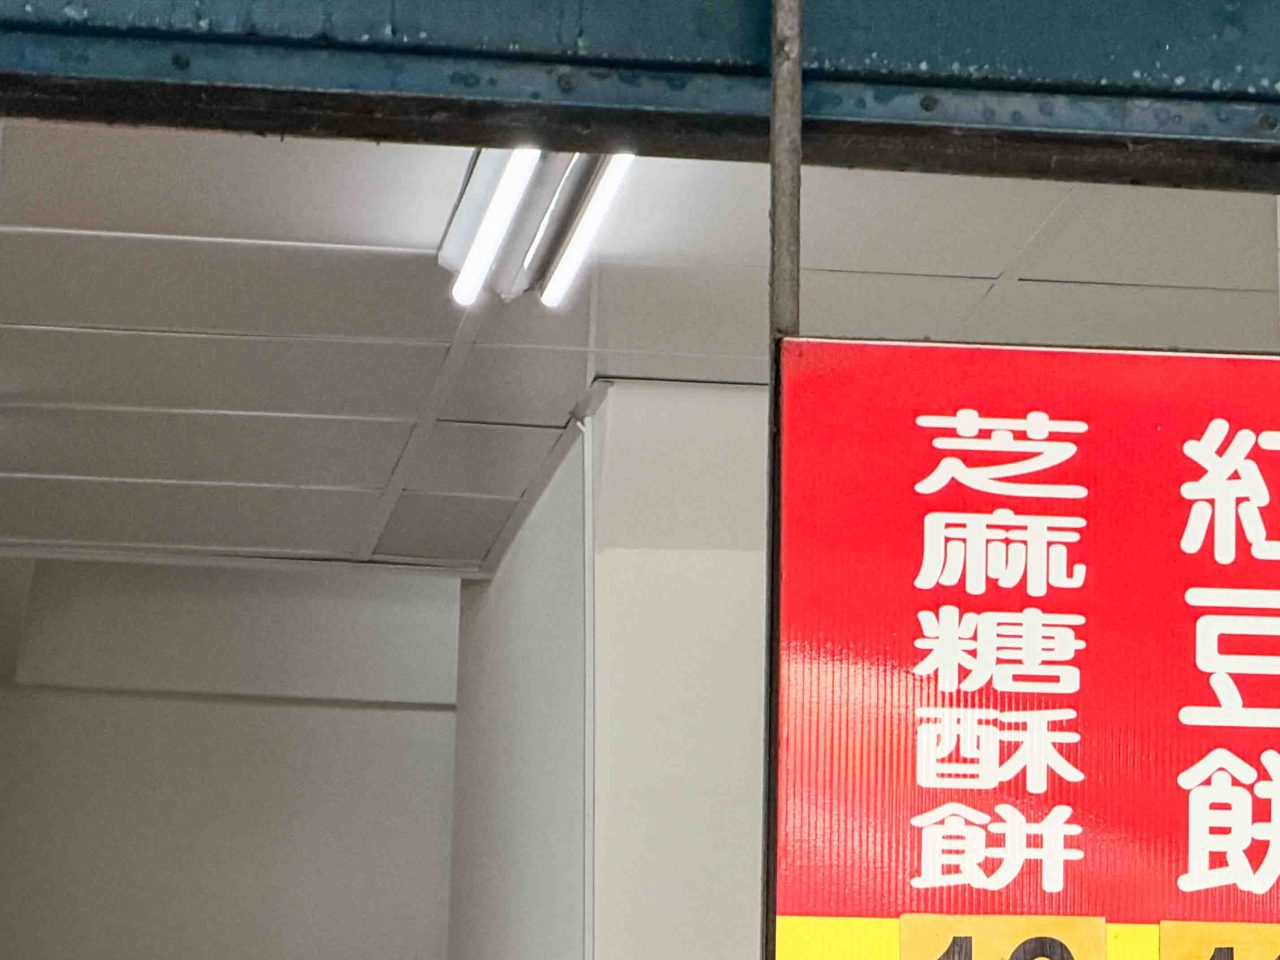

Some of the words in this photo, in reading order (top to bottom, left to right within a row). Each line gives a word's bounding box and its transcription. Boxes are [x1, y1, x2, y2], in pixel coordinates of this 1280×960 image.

[910, 408, 1089, 893] 芝麻糖酥餅
